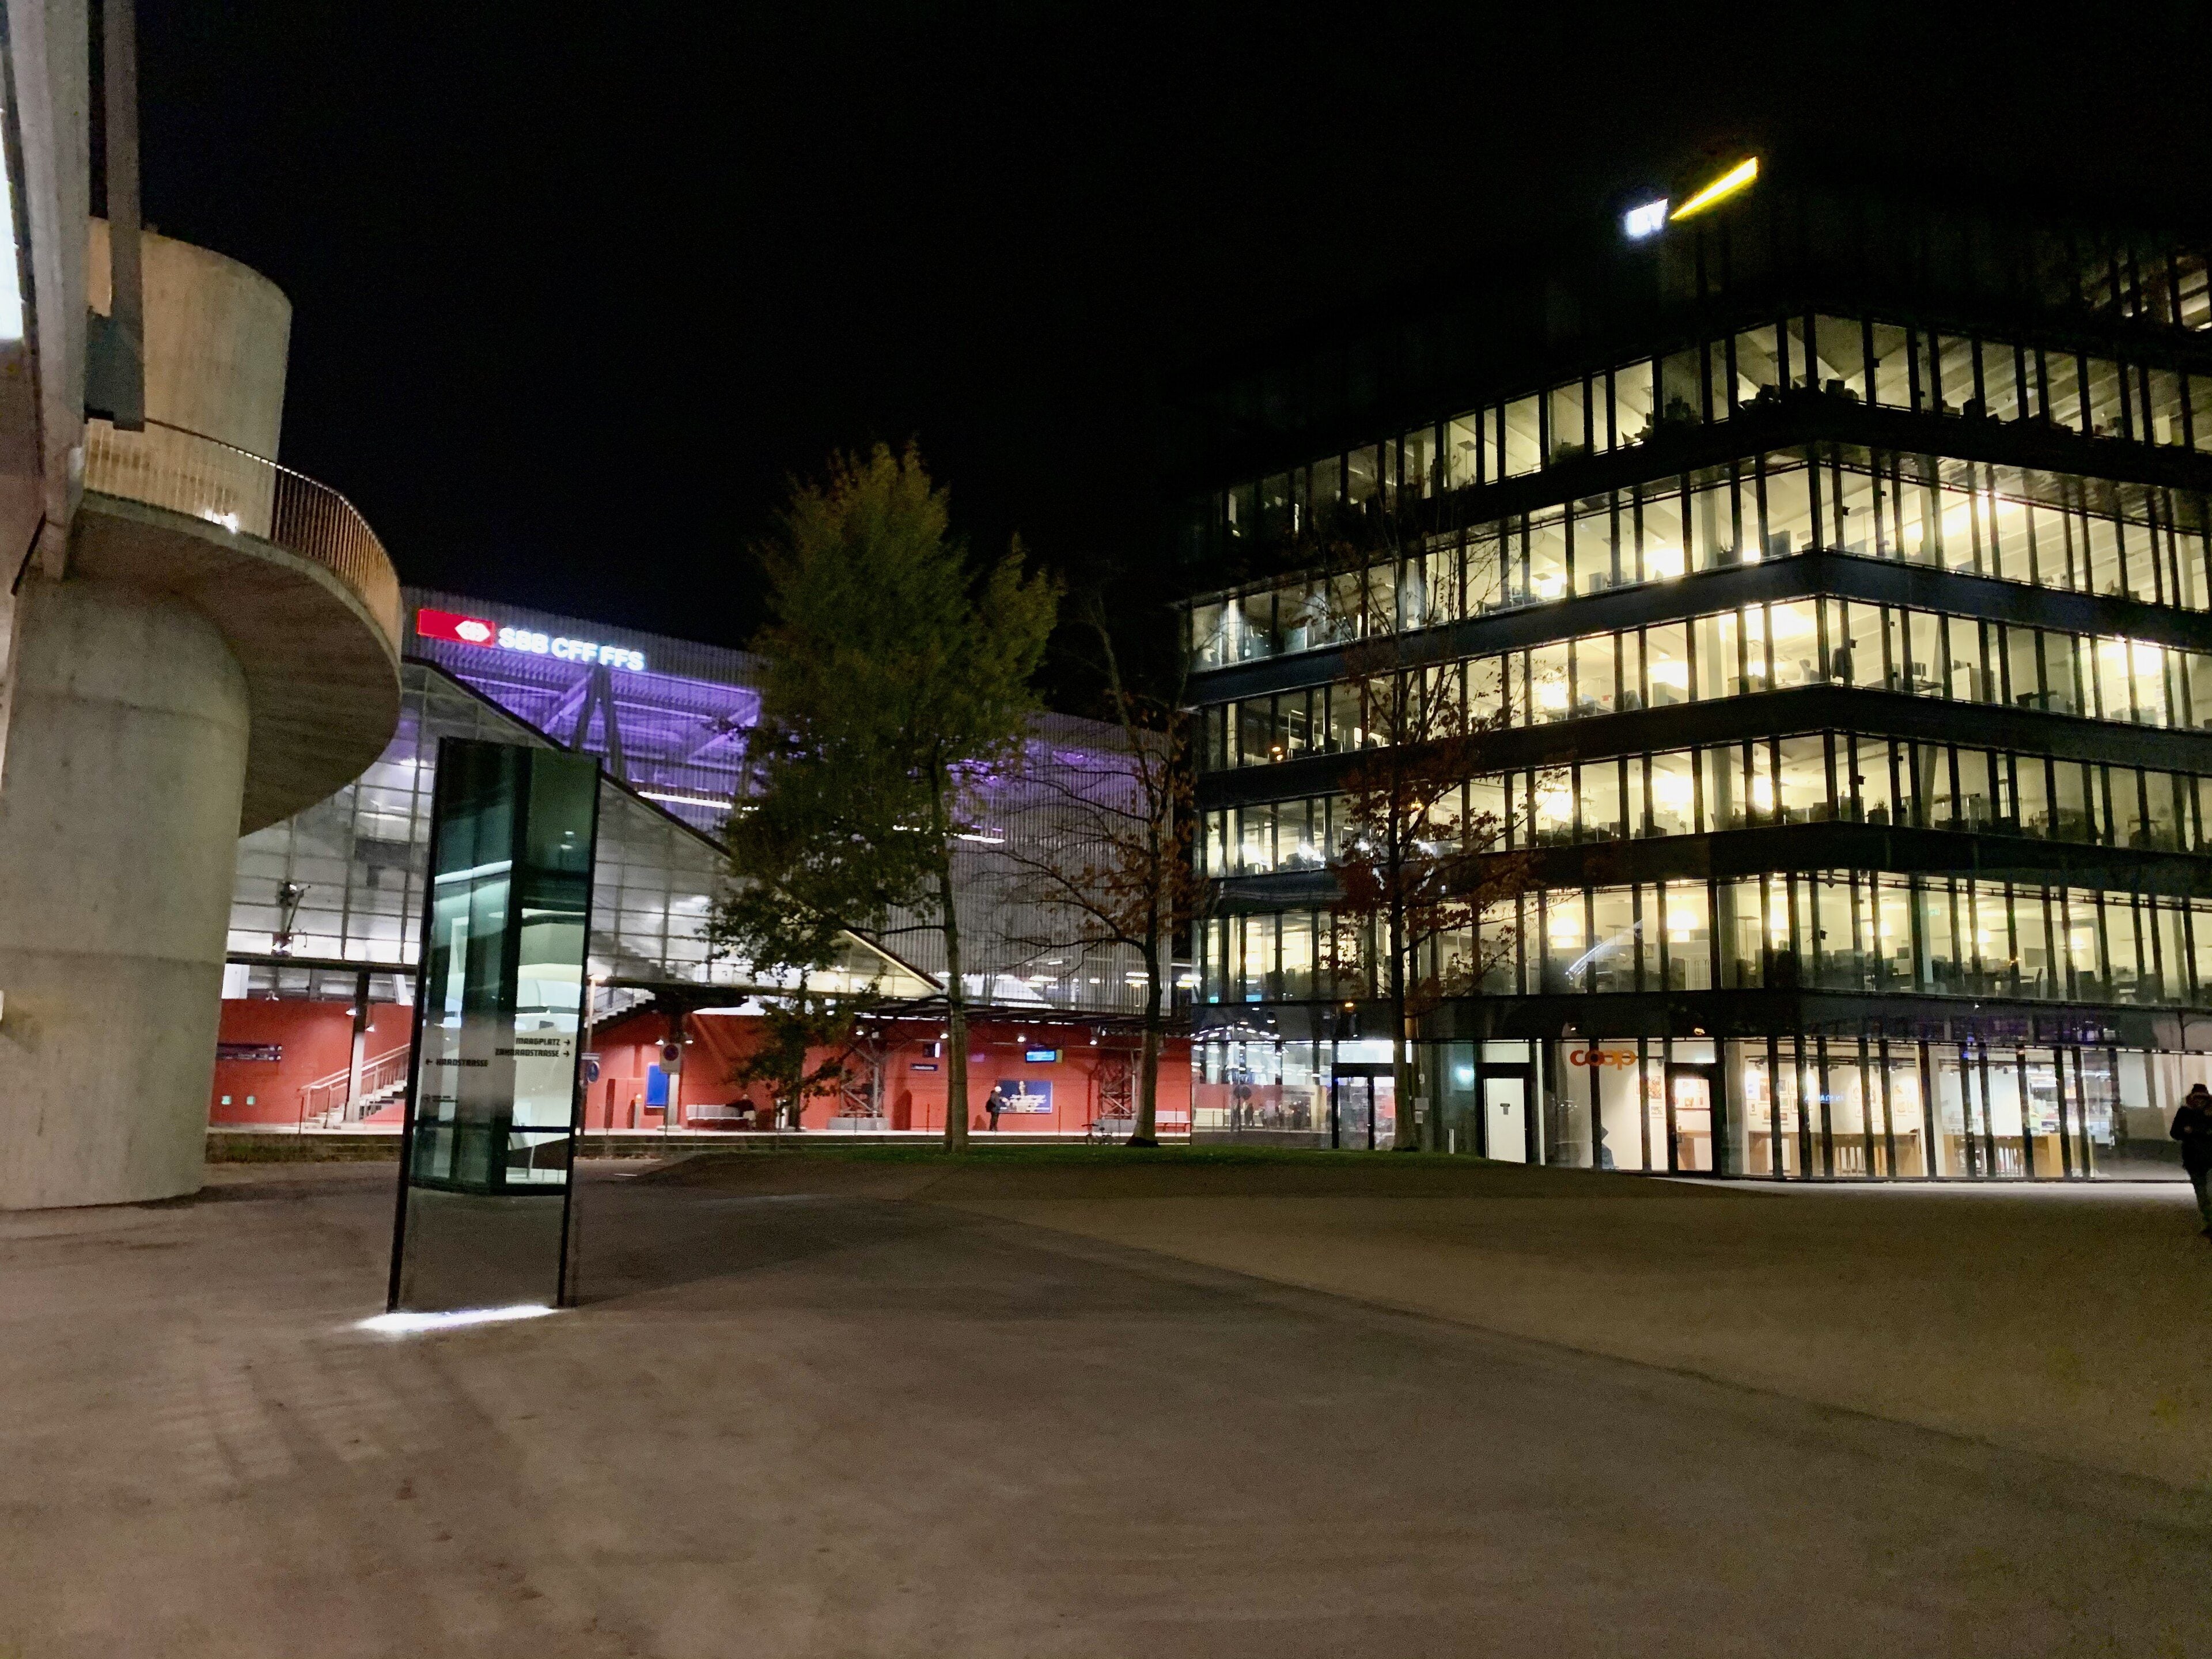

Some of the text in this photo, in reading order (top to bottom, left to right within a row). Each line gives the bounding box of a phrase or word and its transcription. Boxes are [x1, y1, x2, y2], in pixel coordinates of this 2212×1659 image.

[498, 627, 645, 671] SBB CFF FFS
[1570, 1050, 1636, 1070] coop
